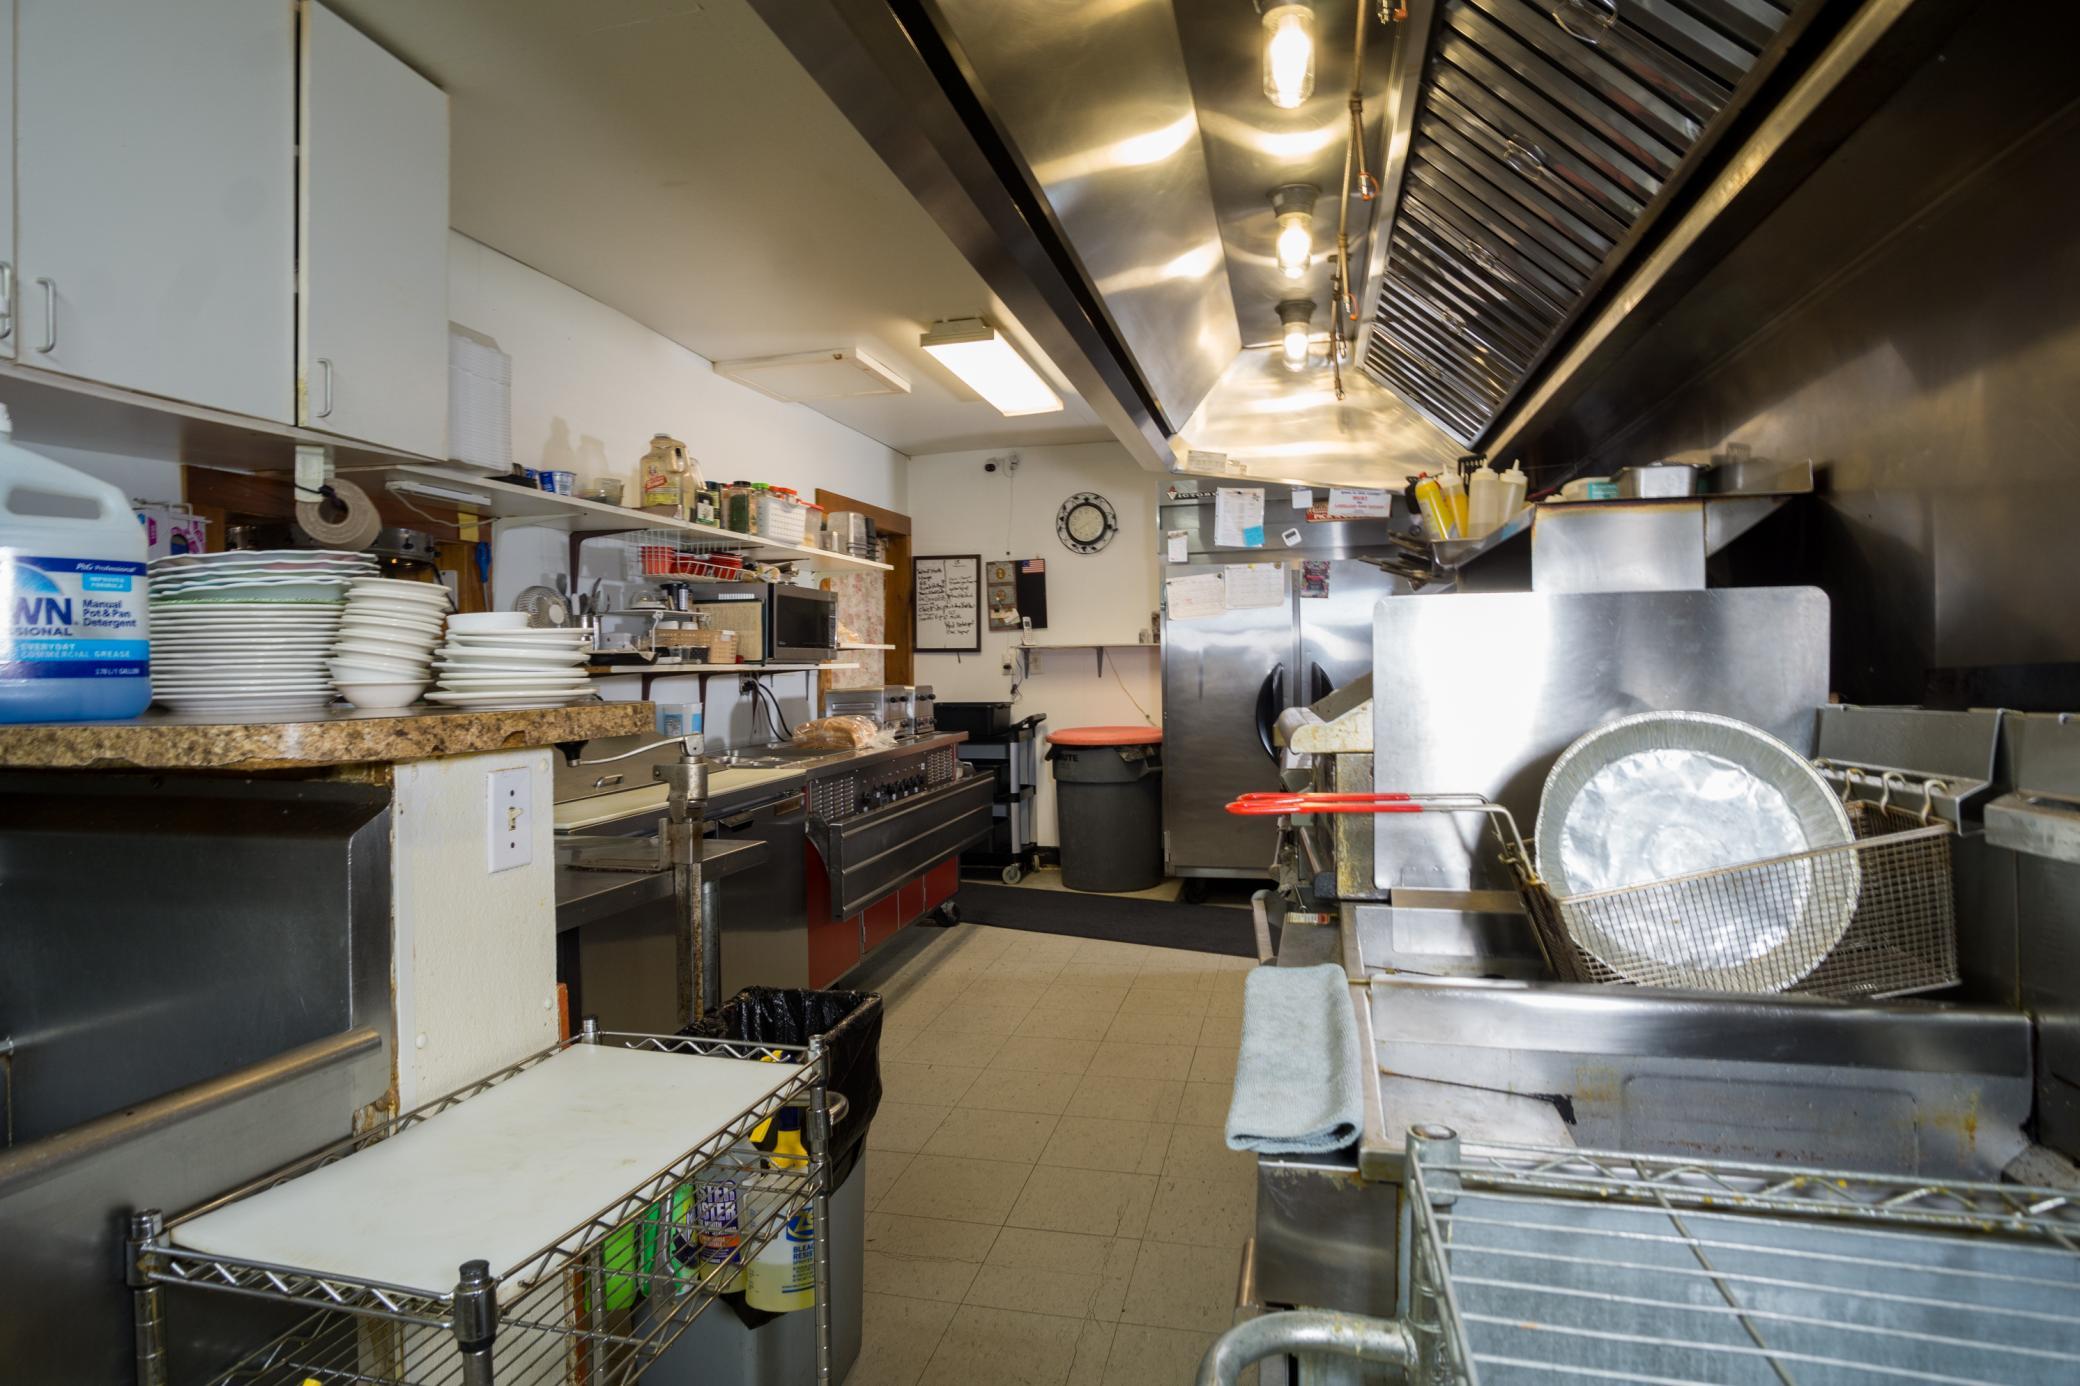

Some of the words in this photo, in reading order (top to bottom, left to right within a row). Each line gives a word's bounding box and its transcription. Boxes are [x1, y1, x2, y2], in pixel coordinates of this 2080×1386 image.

[82, 600, 122, 609] Manual
[13, 597, 73, 625] WN
[82, 608, 102, 618] Pot
[112, 610, 131, 618] Pan
[82, 618, 137, 629] Detergent
[14, 627, 73, 636] SIONAL
[698, 1201, 737, 1222] STER
[793, 1244, 815, 1254] BLEA
[793, 1252, 814, 1261] RESIS
